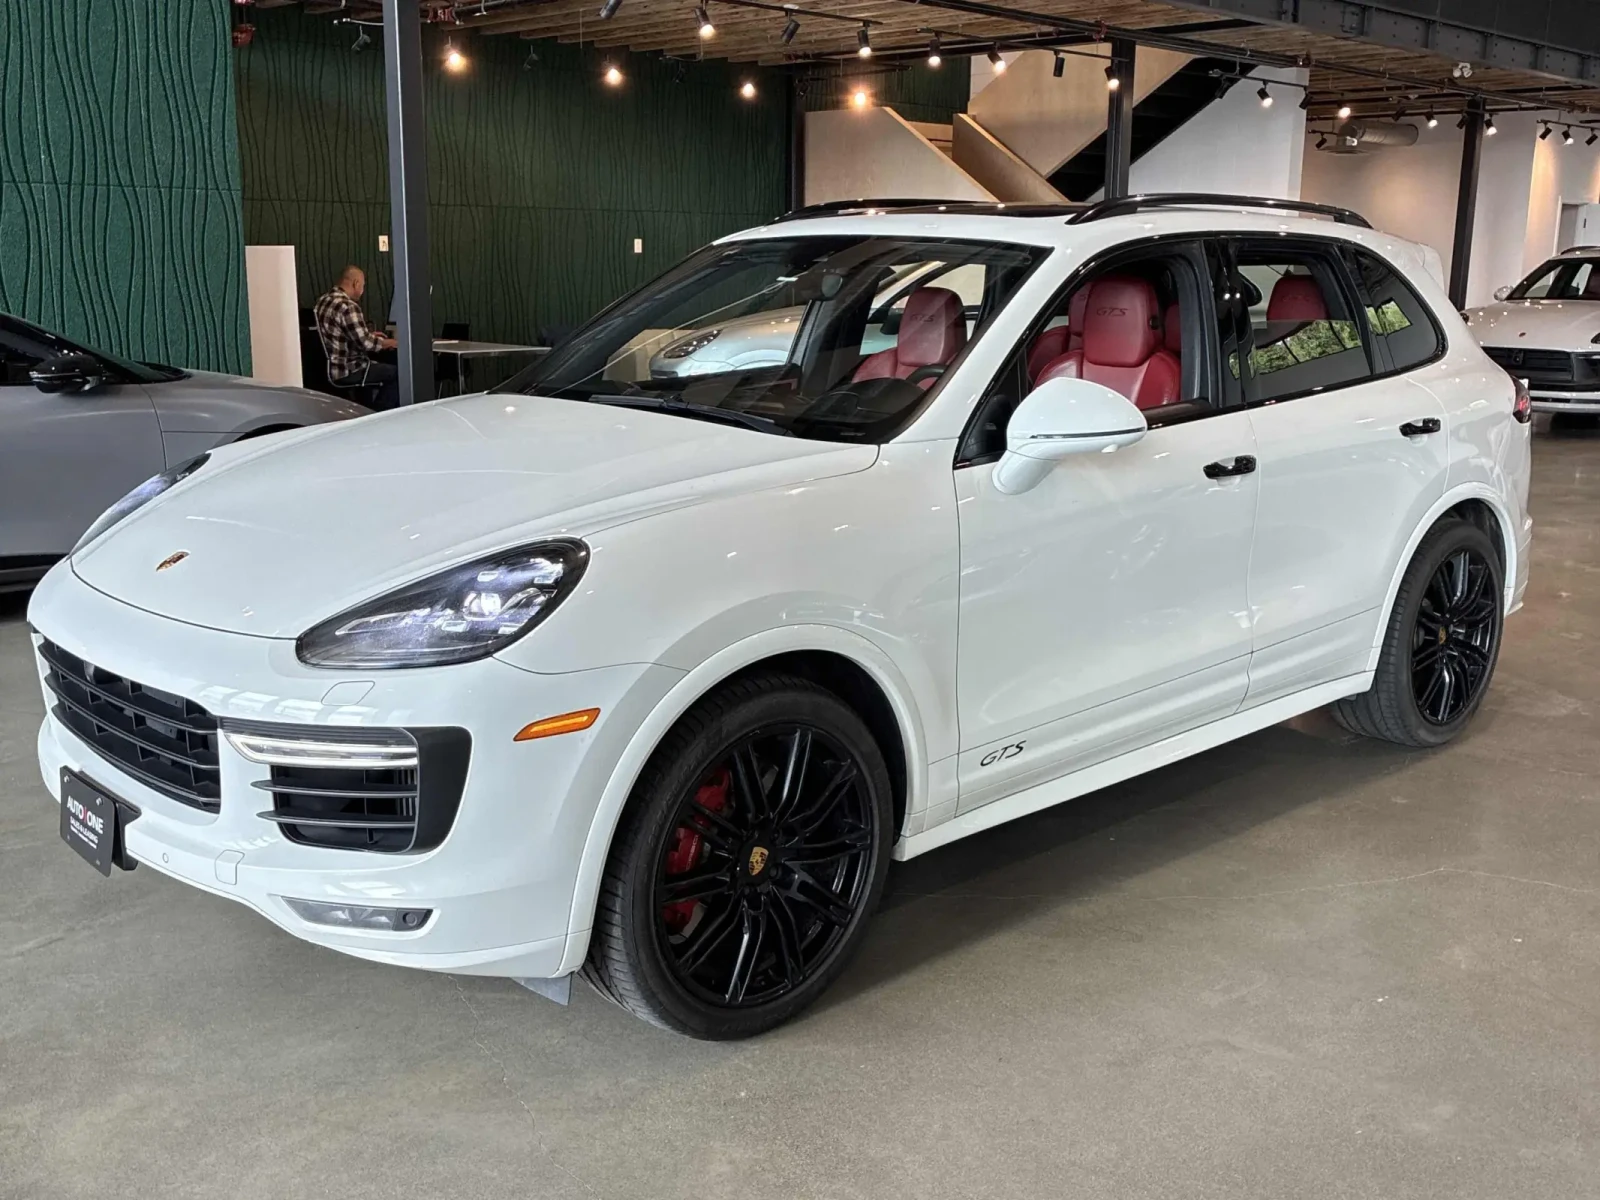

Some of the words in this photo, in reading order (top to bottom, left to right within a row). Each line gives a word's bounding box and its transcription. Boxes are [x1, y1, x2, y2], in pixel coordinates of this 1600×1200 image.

[1096, 307, 1129, 317] GTS
[980, 740, 1027, 767] GTS
[87, 811, 104, 834] ONE
